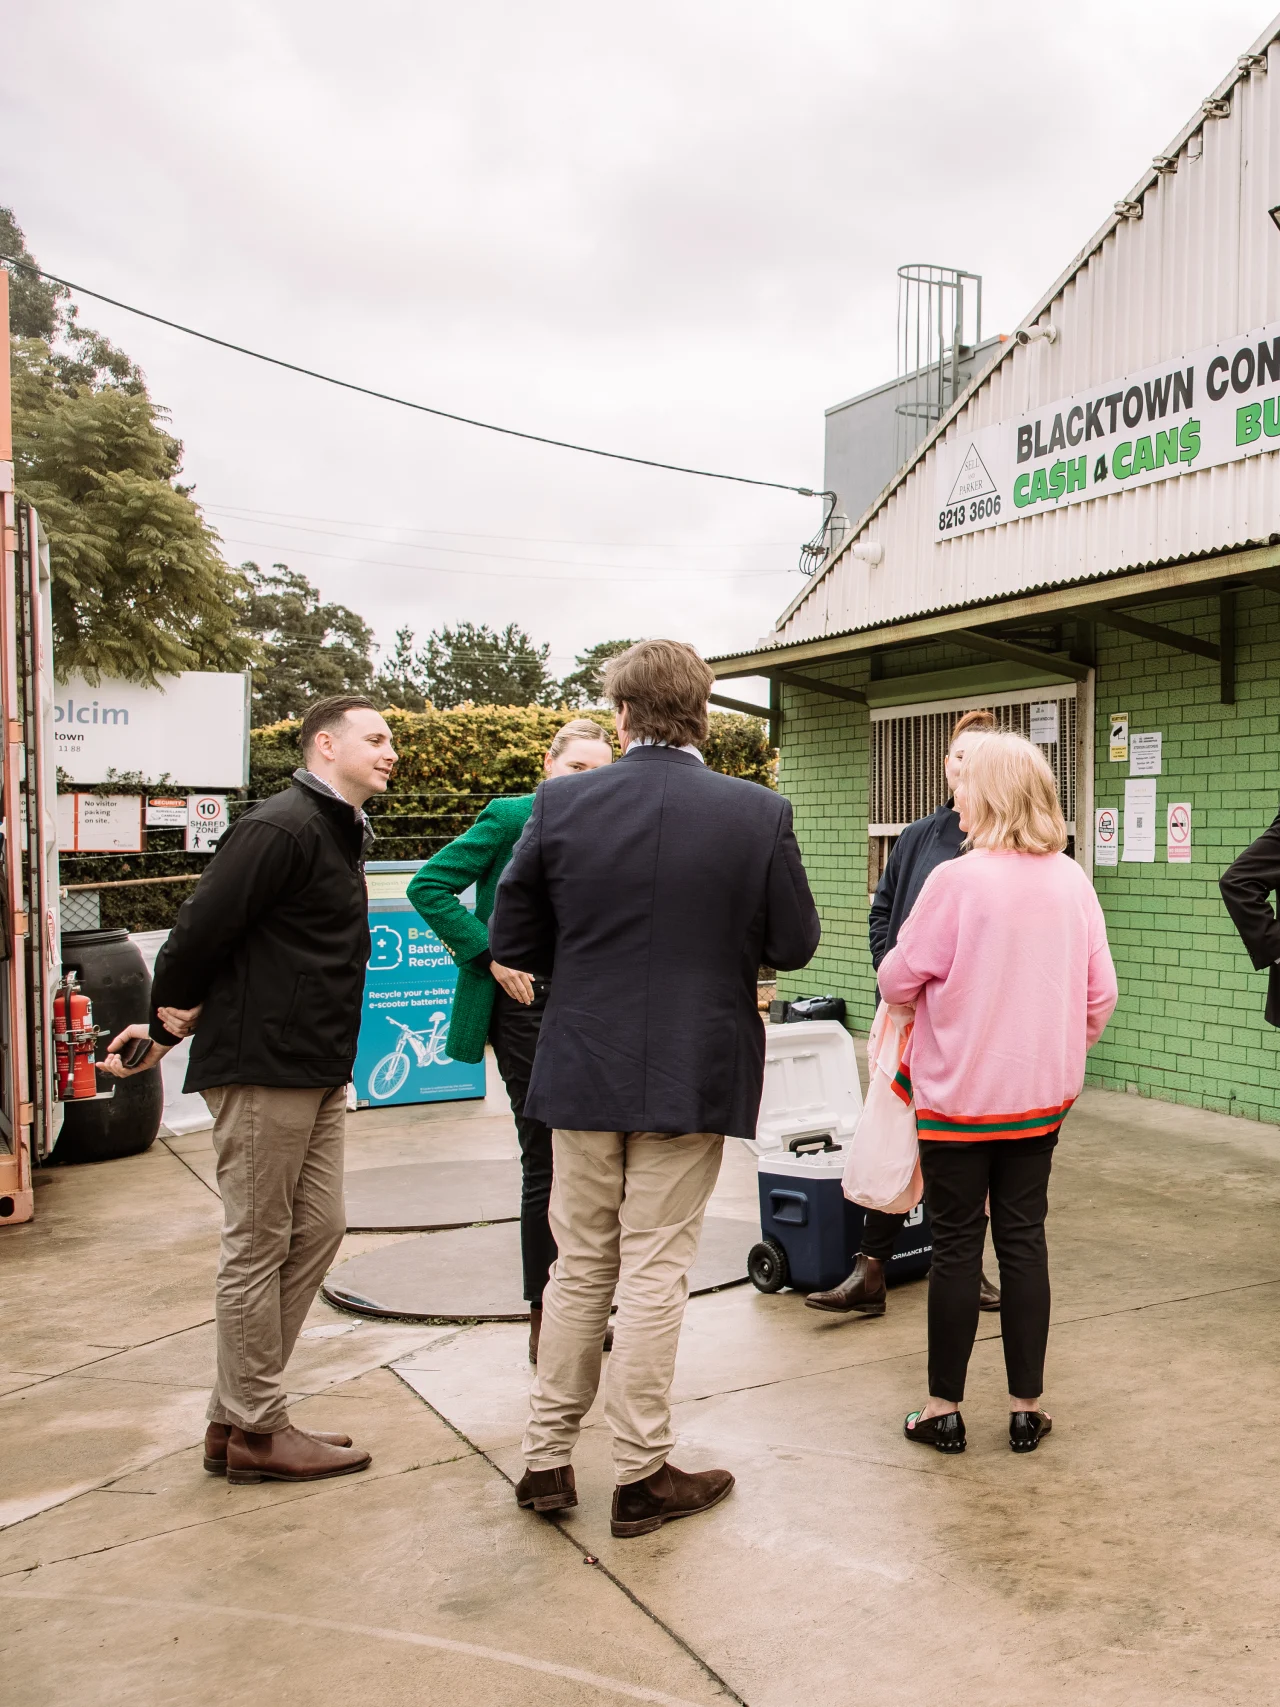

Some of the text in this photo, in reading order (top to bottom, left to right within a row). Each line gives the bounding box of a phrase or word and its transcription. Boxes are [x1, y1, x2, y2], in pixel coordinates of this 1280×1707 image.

[1016, 365, 1196, 464] BLACKTOWN
[964, 457, 980, 472] SELL
[1093, 453, 1109, 484] 4
[959, 479, 983, 496] PARKER
[938, 494, 1002, 531] 8213 3606
[200, 803, 216, 815] 10
[190, 820, 226, 828] SHARED
[408, 927, 439, 941] B-c
[408, 944, 449, 955] Batter
[368, 990, 402, 1000] Recycle
[403, 990, 422, 998] your
[424, 988, 450, 996] e-bike
[368, 1000, 409, 1009] e-scooter
[411, 997, 448, 1007] batteries
[891, 1247, 923, 1260] ORMANCE
